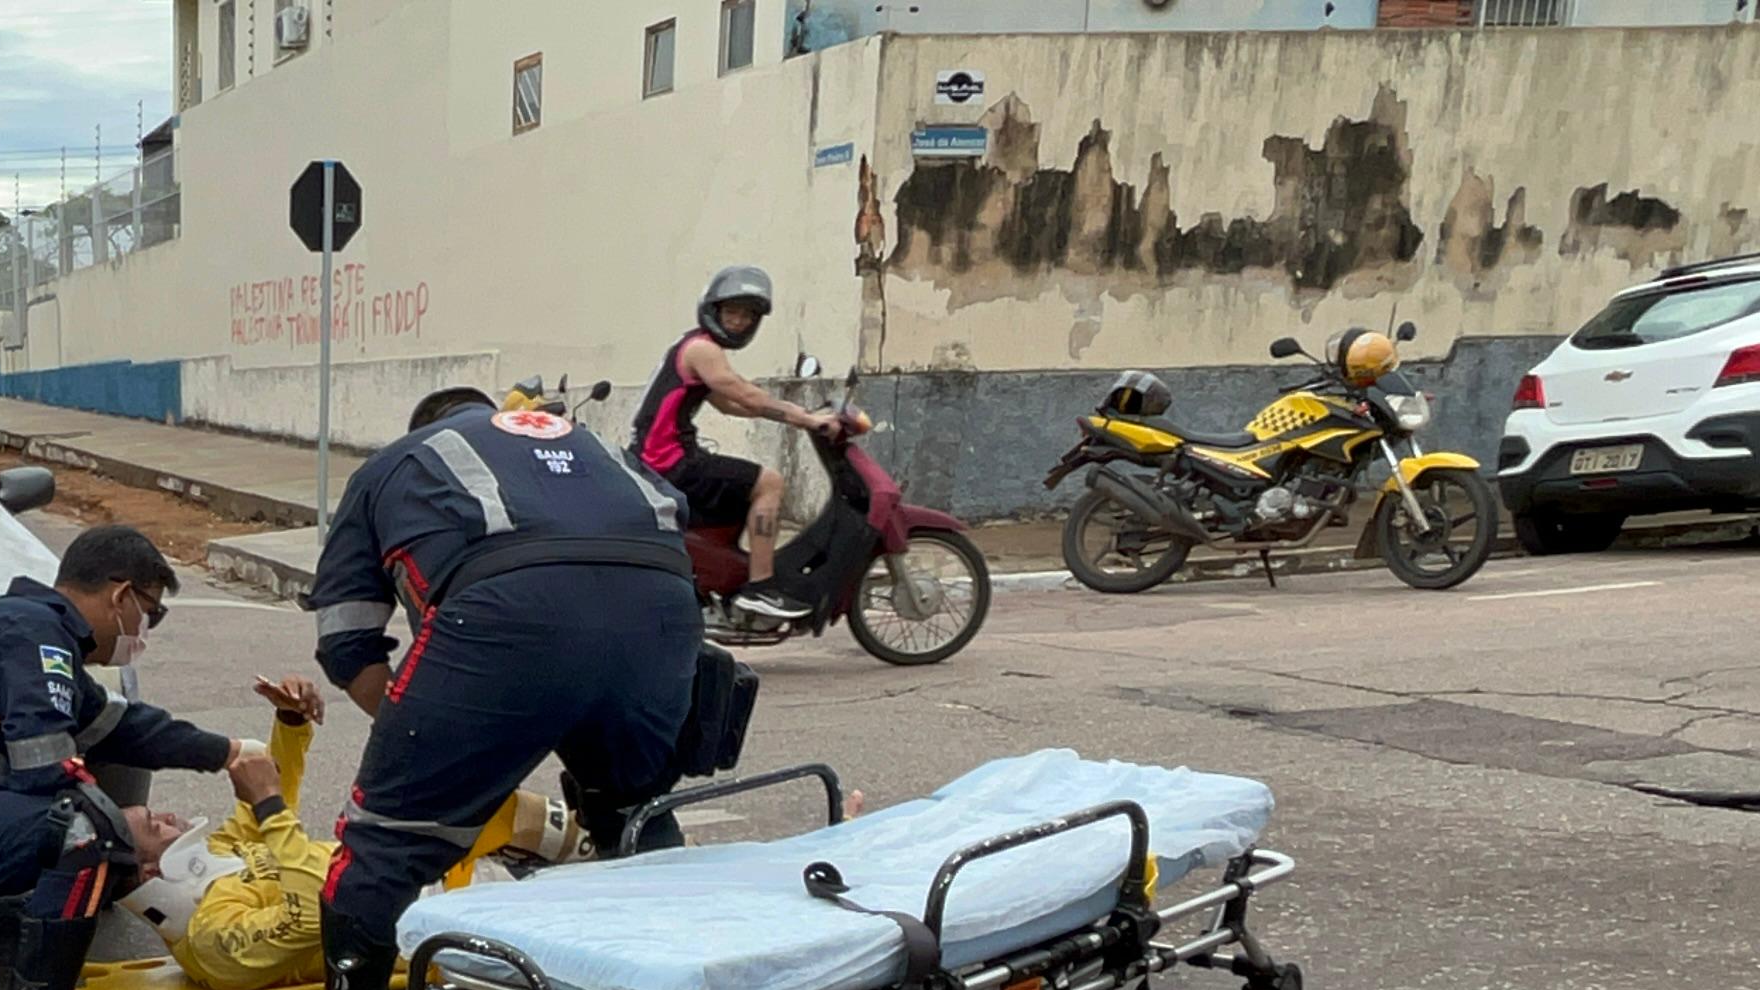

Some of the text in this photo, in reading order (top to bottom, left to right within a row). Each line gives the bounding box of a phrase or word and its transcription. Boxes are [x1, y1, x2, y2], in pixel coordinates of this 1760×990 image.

[230, 277, 293, 316] PALESTINA
[534, 448, 574, 461] SAMU
[546, 460, 572, 475] 192
